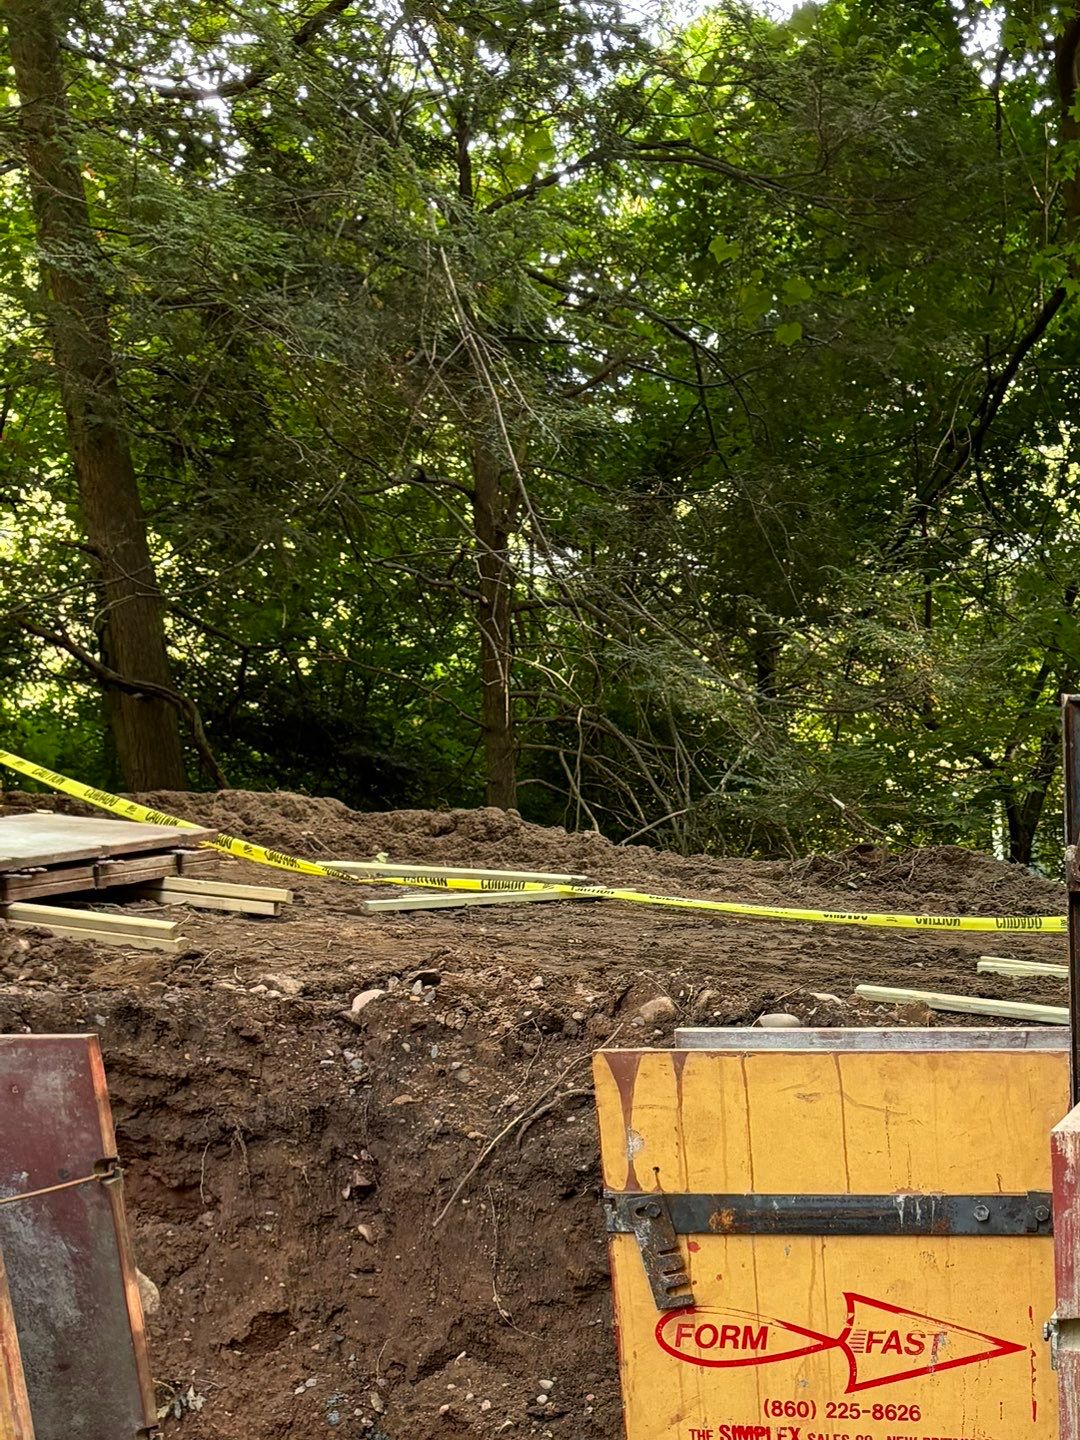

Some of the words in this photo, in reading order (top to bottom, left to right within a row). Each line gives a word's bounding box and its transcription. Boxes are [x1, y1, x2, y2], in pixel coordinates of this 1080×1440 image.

[674, 1323, 769, 1351] FORM
[864, 1329, 946, 1356] FAST
[763, 1398, 818, 1420] (860)
[825, 1401, 922, 1422] 225-8626
